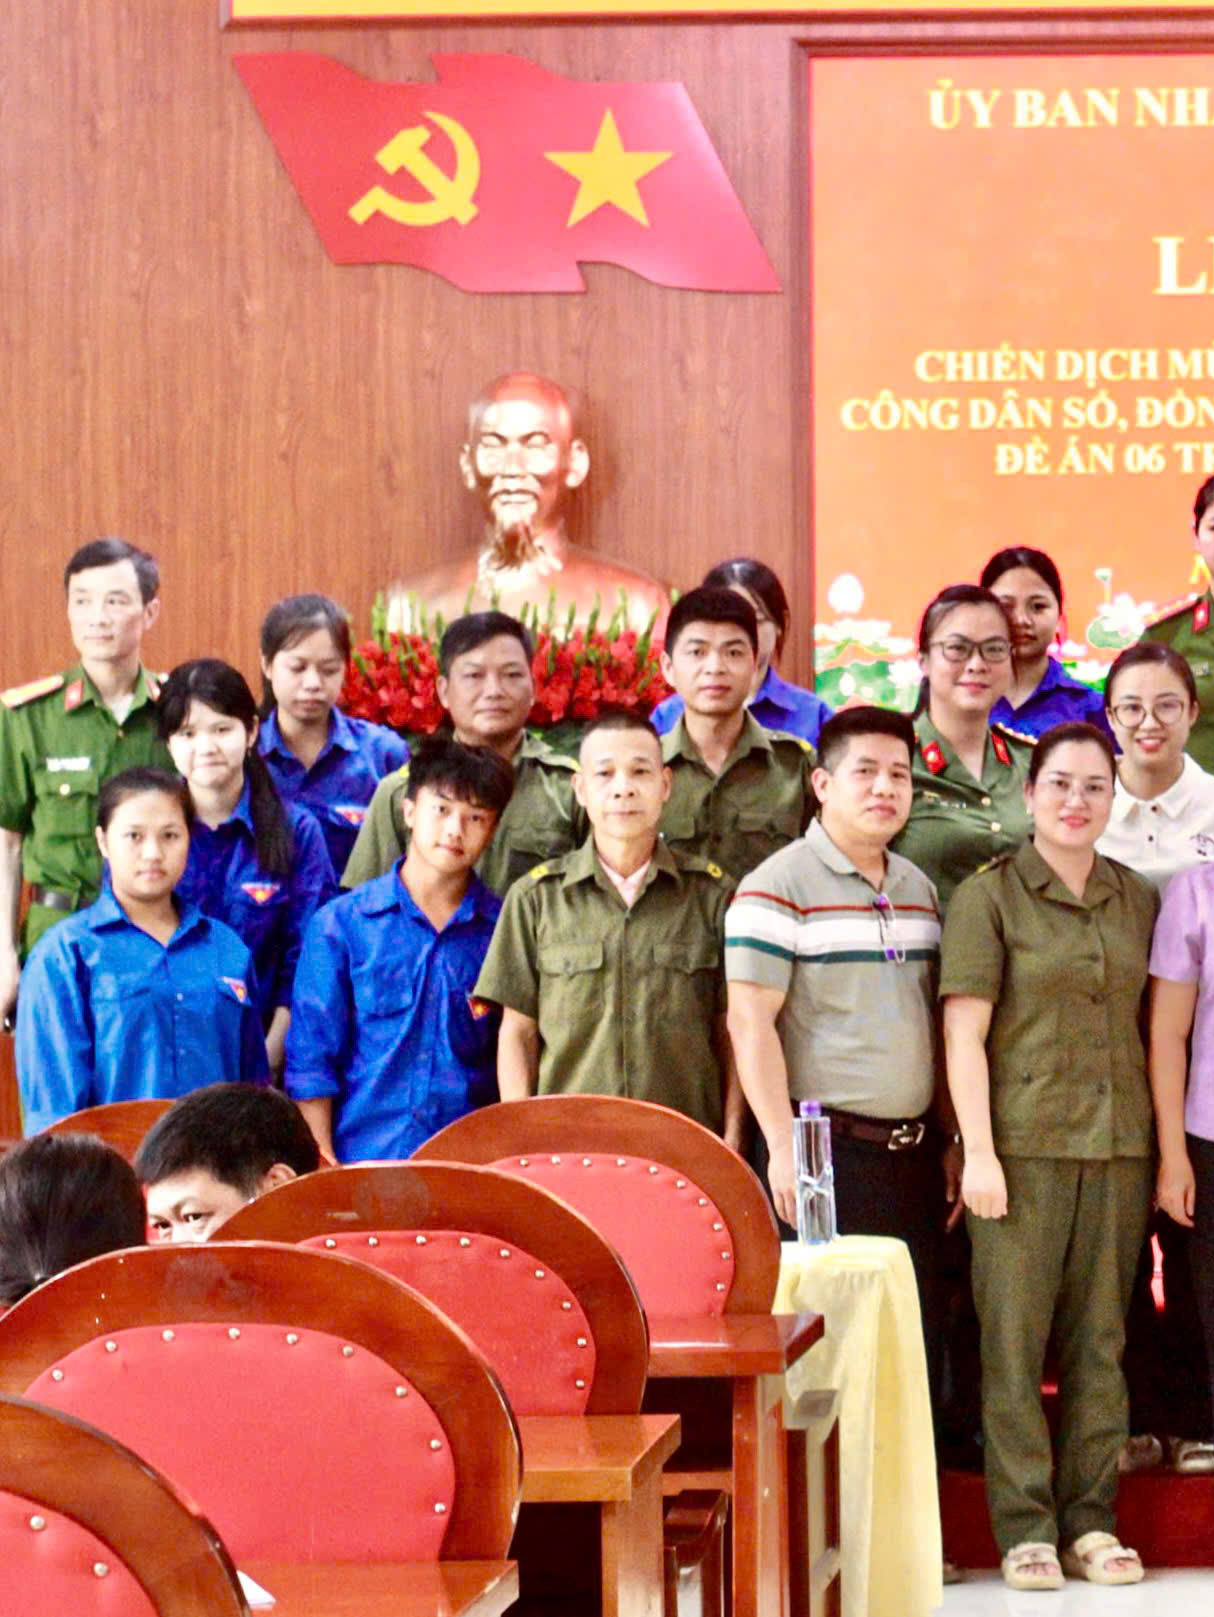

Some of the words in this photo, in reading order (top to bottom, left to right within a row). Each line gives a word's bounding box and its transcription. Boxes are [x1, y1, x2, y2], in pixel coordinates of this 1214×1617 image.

[928, 78, 1002, 129] ỦY
[1012, 87, 1120, 128] BAN
[1055, 348, 1158, 388] DỊCH
[839, 388, 960, 430] CÔNG
[968, 388, 1053, 429] DÂN
[1057, 434, 1116, 474] ÁN
[1123, 443, 1167, 473] 06
